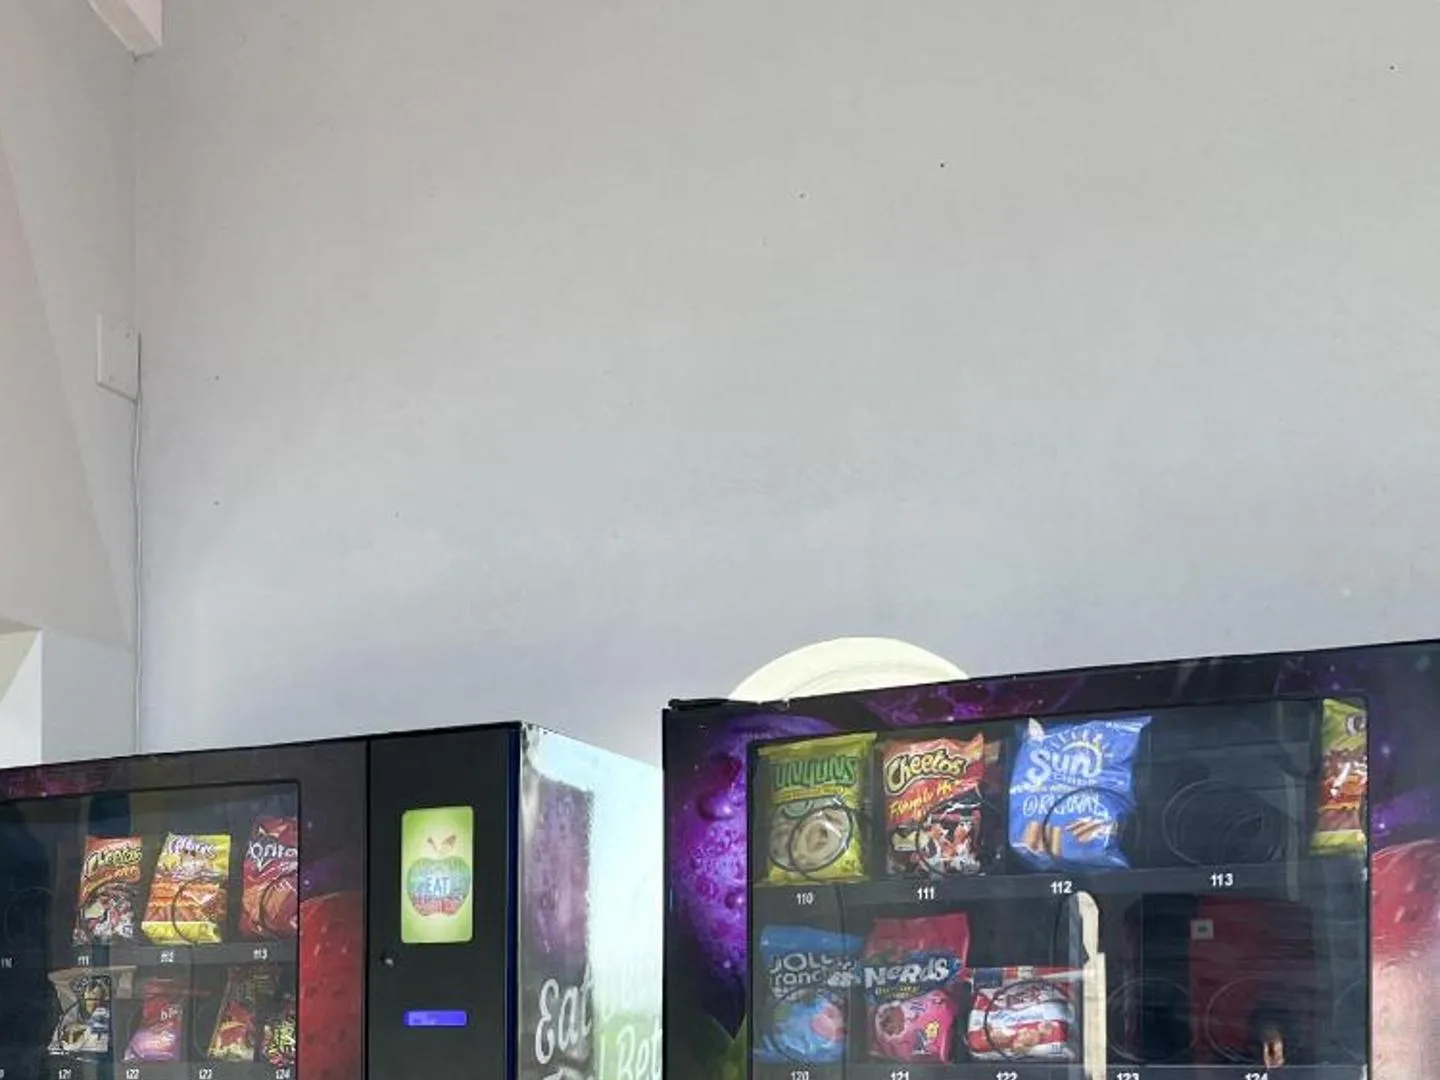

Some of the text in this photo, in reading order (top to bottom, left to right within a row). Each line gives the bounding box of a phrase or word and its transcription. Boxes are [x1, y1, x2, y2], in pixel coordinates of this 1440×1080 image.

[887, 750, 965, 793] Cheetos
[1026, 749, 1104, 784] Sun
[1210, 874, 1233, 887] 113
[917, 887, 935, 899] 111
[1050, 881, 1073, 894] 112
[796, 893, 814, 905] 110
[535, 962, 592, 1064] Eat
